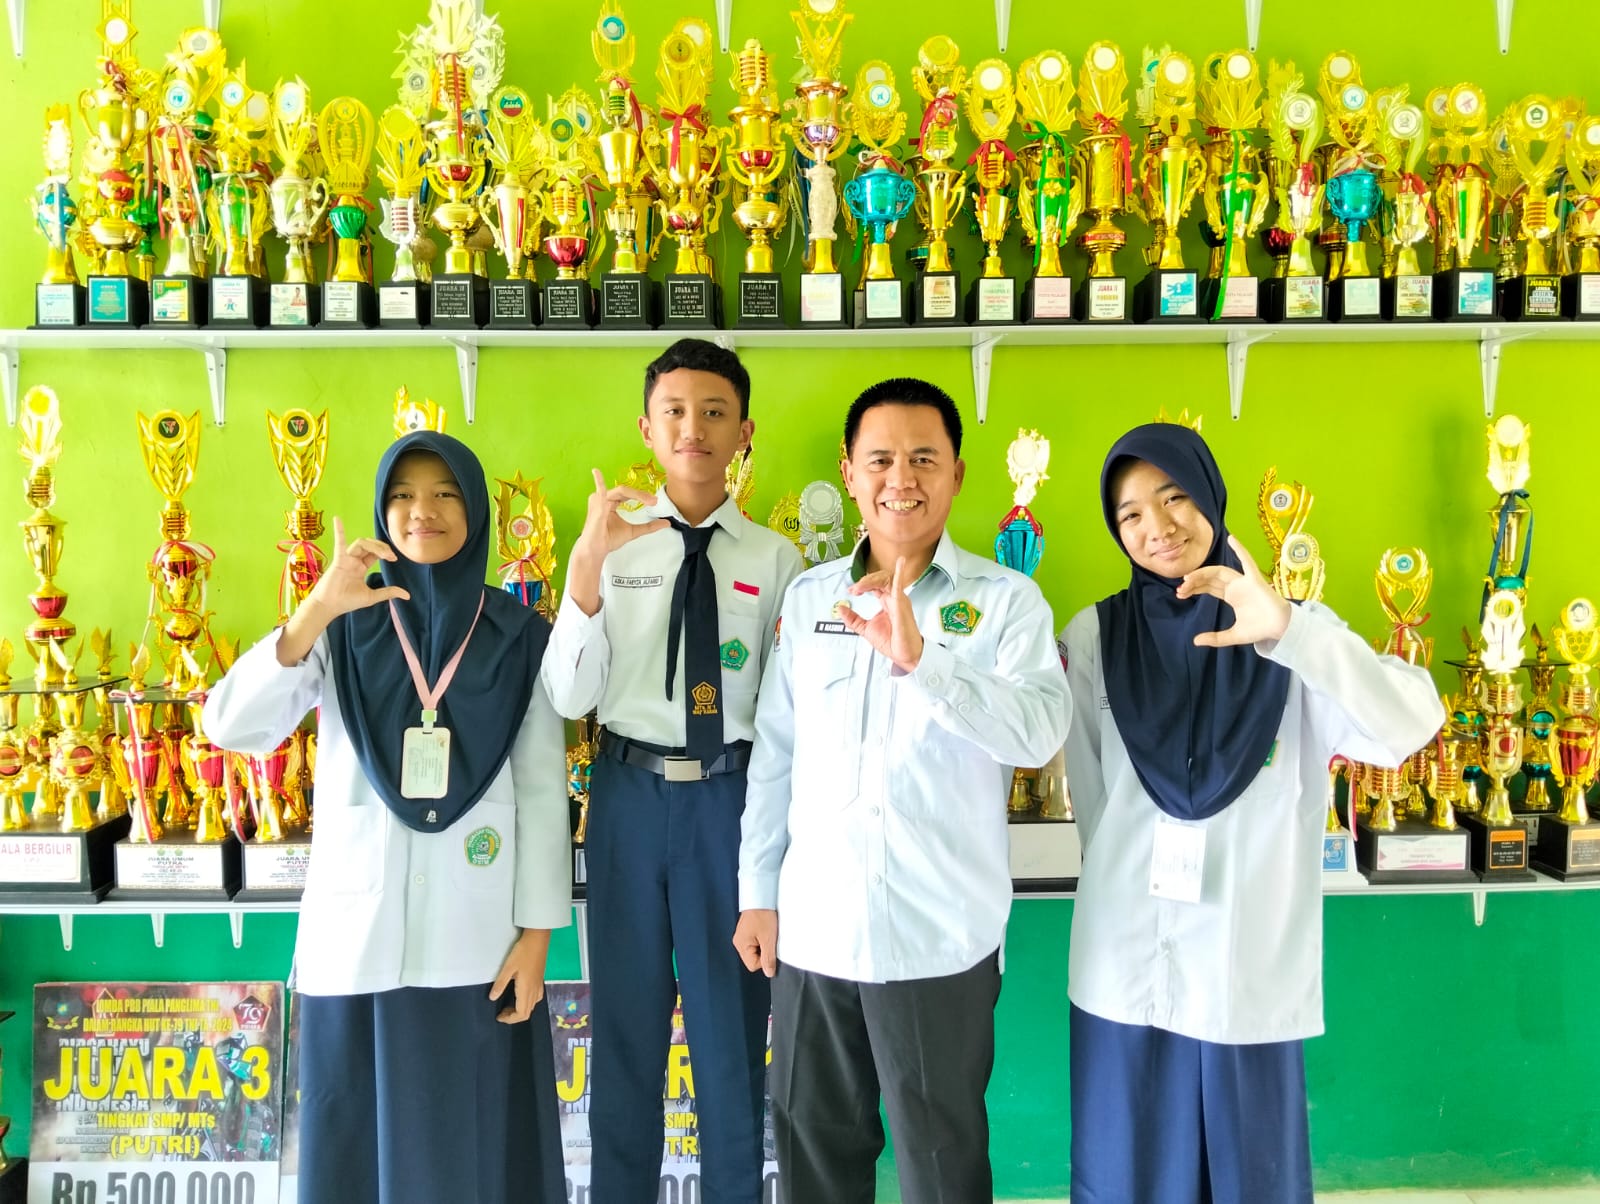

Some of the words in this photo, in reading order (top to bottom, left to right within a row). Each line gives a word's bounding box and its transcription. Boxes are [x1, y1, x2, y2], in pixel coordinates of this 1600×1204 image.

[24, 842, 73, 855] BERGILIR
[96, 998, 123, 1013] LOMBA
[142, 998, 164, 1013] PIALA
[43, 1047, 224, 1101] JUARA
[241, 1046, 272, 1101] 3
[96, 1112, 150, 1129] TINGKAT
[110, 1134, 200, 1160] (PUTRI)
[52, 1172, 97, 1204] Rp
